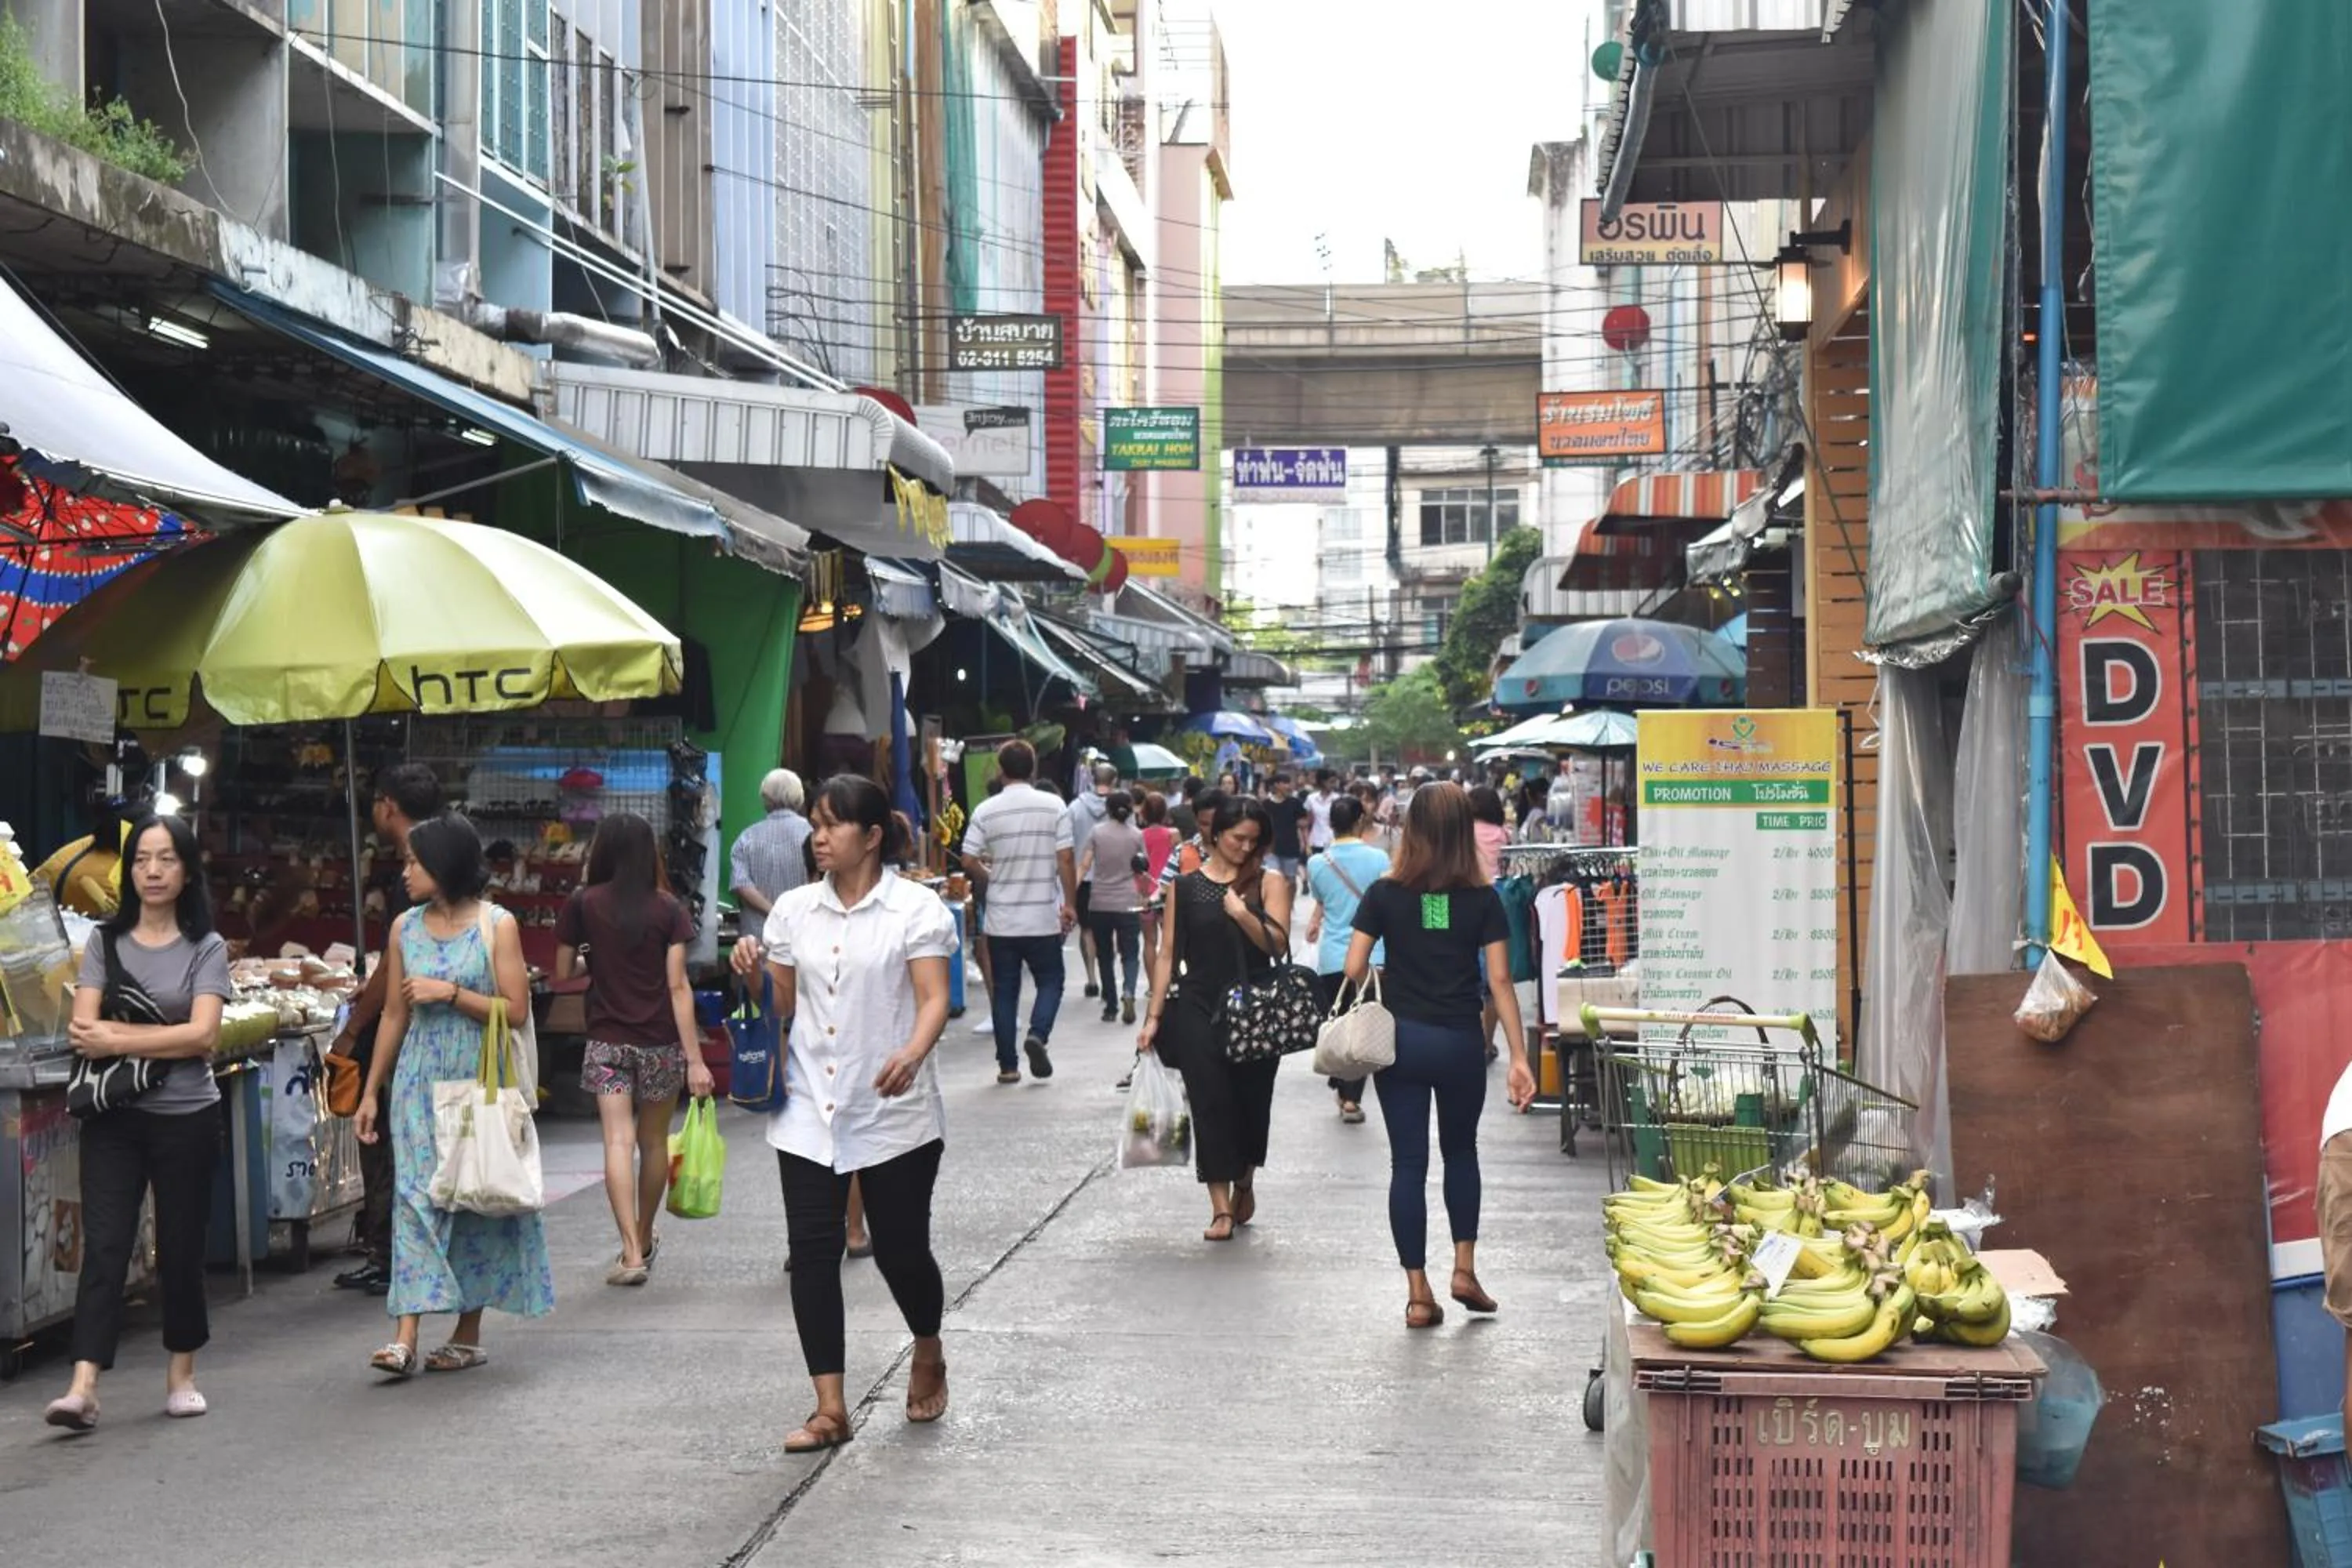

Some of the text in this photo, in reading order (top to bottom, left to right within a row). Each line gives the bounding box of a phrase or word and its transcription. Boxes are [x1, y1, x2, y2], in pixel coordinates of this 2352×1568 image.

[956, 318, 1054, 343] บ้านสบาย
[1236, 448, 1344, 483] ทำฟัน-จัดฟัน
[2070, 575, 2164, 607] SALE
[1606, 677, 1669, 696] pepsi
[118, 687, 172, 720] TC
[1642, 762, 1664, 773] WE
[1669, 762, 1710, 773] CARE
[1758, 761, 1831, 773] MASSAGE
[1653, 787, 1731, 800] PROMOTION
[2080, 637, 2169, 930] DVD
[1762, 815, 1791, 827] TIME
